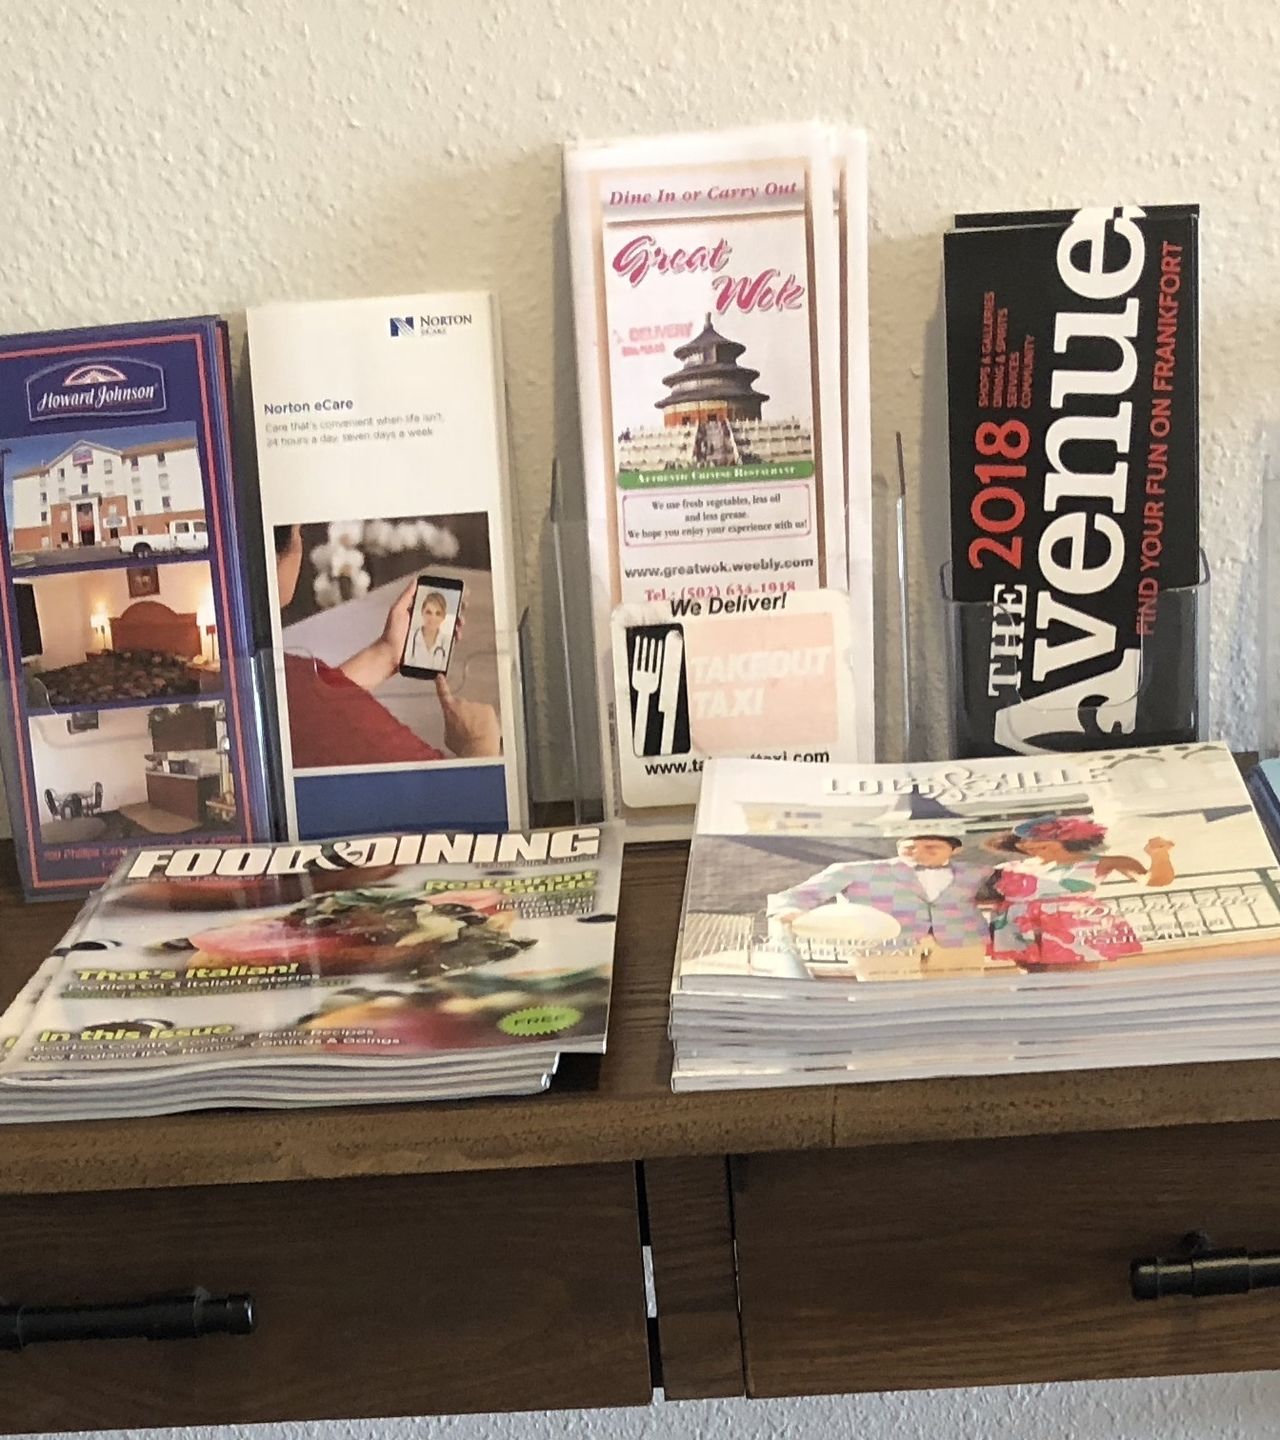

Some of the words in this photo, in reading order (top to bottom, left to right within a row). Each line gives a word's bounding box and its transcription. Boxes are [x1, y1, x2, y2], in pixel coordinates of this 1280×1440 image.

[609, 190, 650, 206] Dine
[657, 189, 676, 203] In
[681, 189, 703, 200] or
[706, 184, 759, 202] Carry
[764, 181, 797, 196] Out
[612, 234, 733, 286] Great
[712, 268, 805, 315] Wok
[1153, 240, 1184, 391] FRANKFORT
[1007, 351, 1020, 407] SERVICES
[37, 388, 94, 412] Howard
[95, 385, 155, 408] Johnson
[264, 401, 310, 415] Norton
[314, 399, 353, 411] eCare
[265, 422, 288, 433] Care
[1150, 399, 1172, 435] ON
[267, 438, 278, 448] 24
[281, 436, 309, 446] hours
[342, 432, 370, 442] seven
[373, 430, 396, 441] days
[994, 206, 1148, 757] Avenue
[1146, 443, 1169, 495] FUN
[652, 501, 665, 510] We
[969, 420, 1031, 571] 2018
[628, 529, 640, 538] We
[642, 529, 662, 540] hope
[664, 528, 680, 538] you
[682, 526, 705, 537] enjoy
[706, 525, 725, 536] your
[728, 523, 772, 534] experience
[774, 521, 793, 531] with
[685, 513, 700, 522] and
[1140, 501, 1165, 570] YOUR
[625, 557, 814, 578] www.greatwok.weebly.com
[670, 598, 701, 618] We
[708, 592, 787, 616] Deliver!
[1136, 576, 1160, 637] FIND
[988, 584, 1028, 699] THE
[692, 686, 766, 719] TAXI
[140, 982, 165, 990] on
